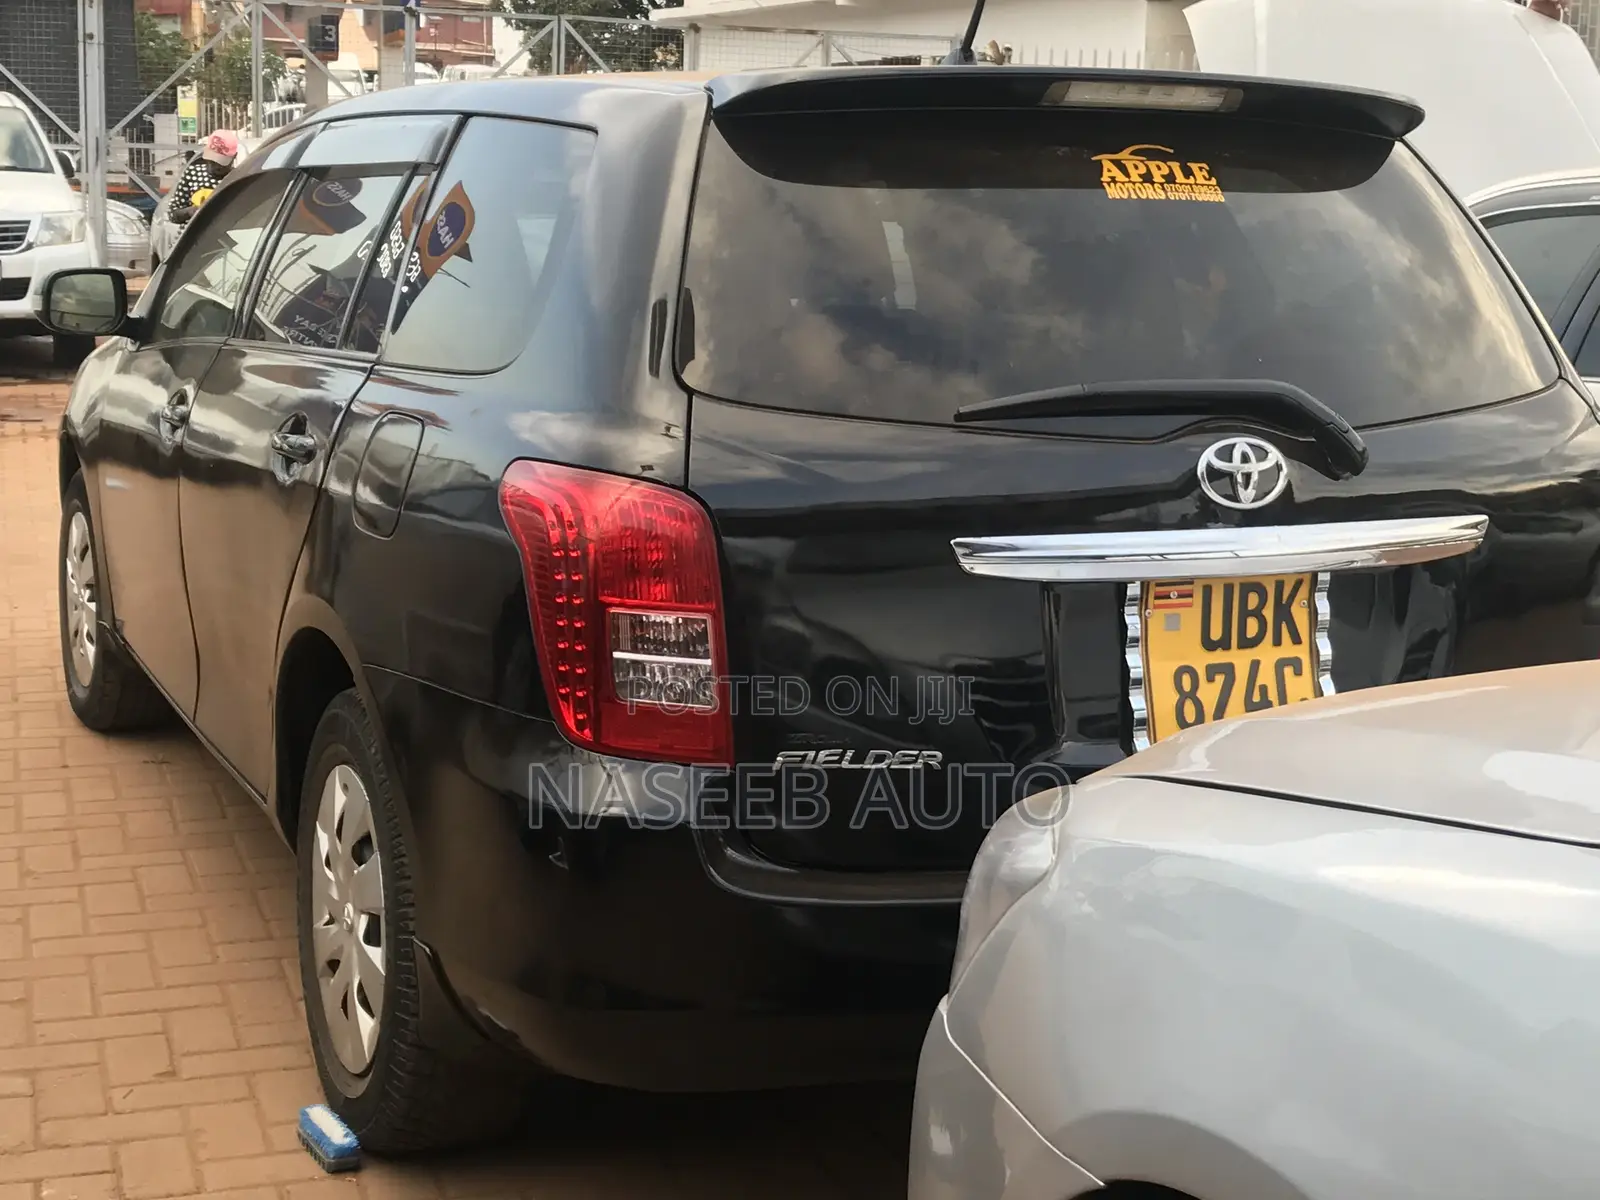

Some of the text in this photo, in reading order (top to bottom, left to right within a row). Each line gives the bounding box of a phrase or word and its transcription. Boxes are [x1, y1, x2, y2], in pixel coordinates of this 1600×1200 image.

[324, 24, 337, 42] 3
[1100, 158, 1217, 185] APPLE
[1102, 182, 1167, 200] MOTORS
[1200, 577, 1304, 652] UBK
[1173, 655, 1304, 730] 874C
[771, 748, 944, 771] FIELDER
